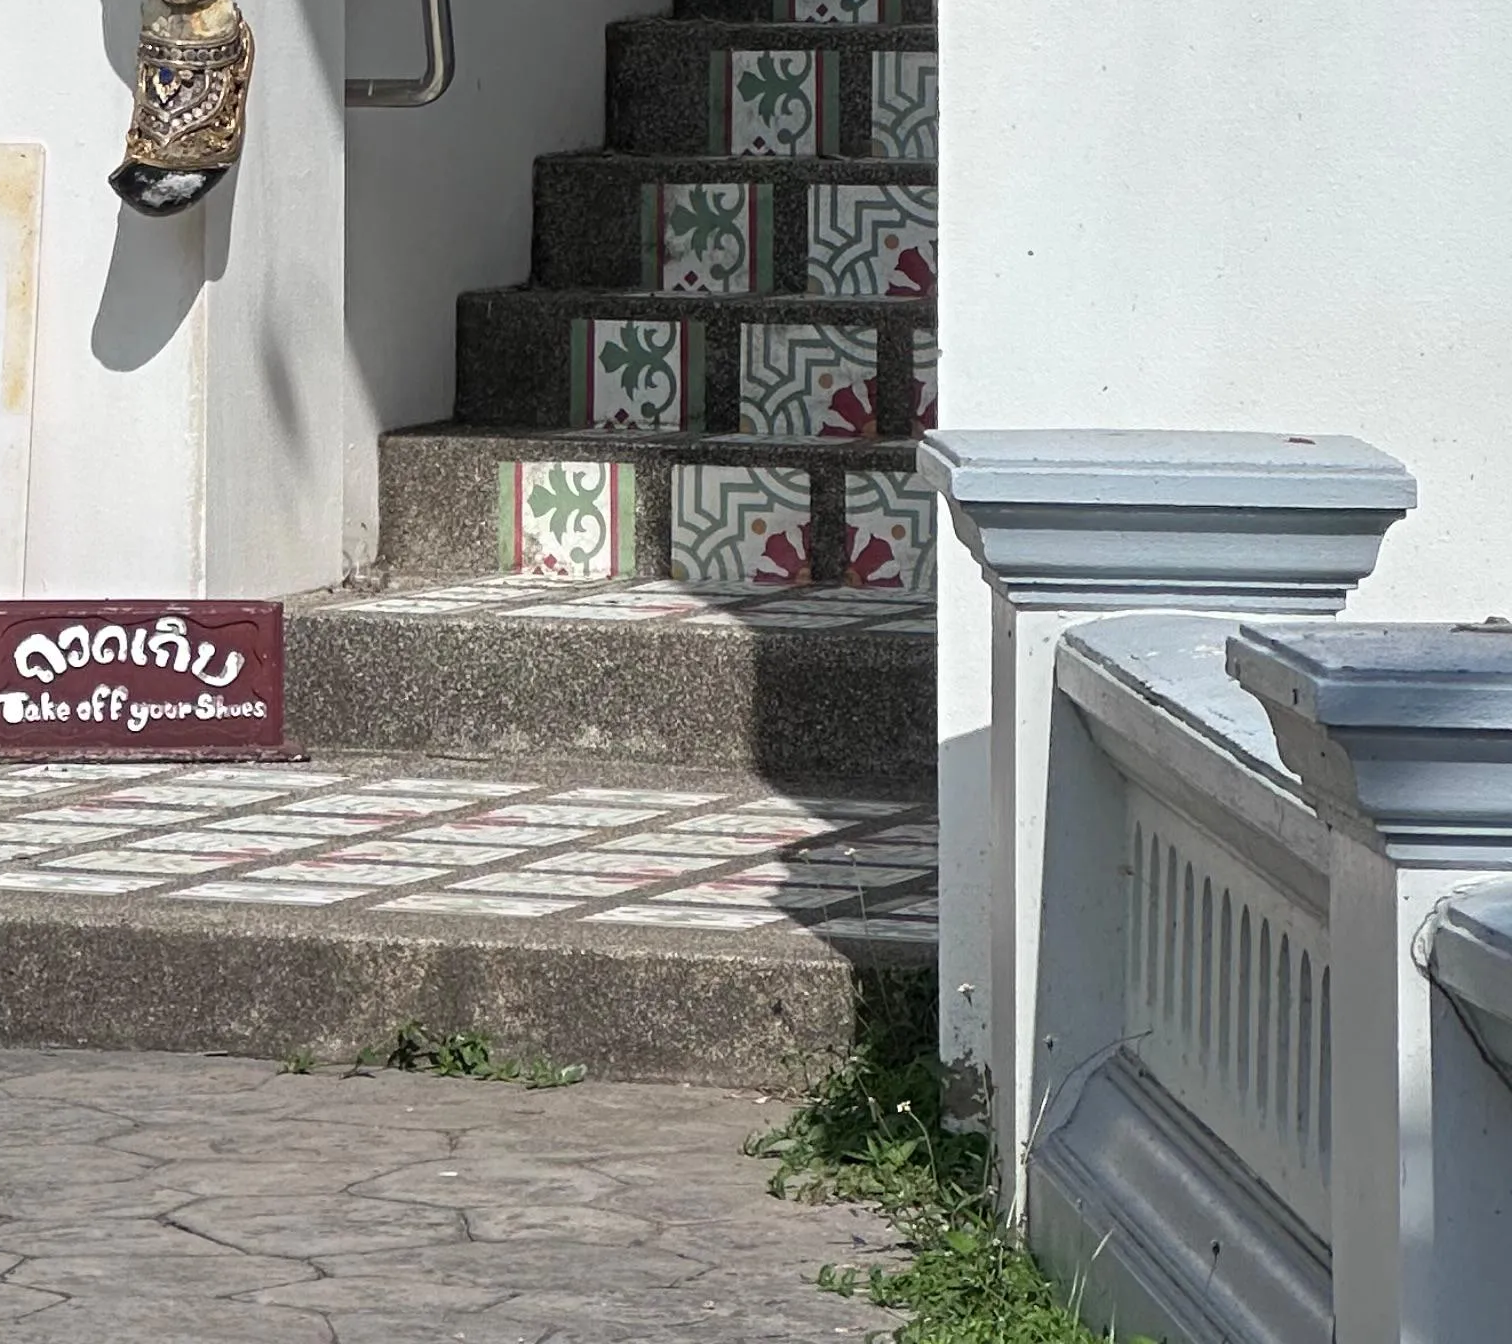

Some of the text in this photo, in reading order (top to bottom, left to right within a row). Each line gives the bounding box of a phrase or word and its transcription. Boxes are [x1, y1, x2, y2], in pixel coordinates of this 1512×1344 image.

[76, 683, 129, 723] off
[127, 701, 192, 732] your
[194, 692, 268, 720] Shoes
